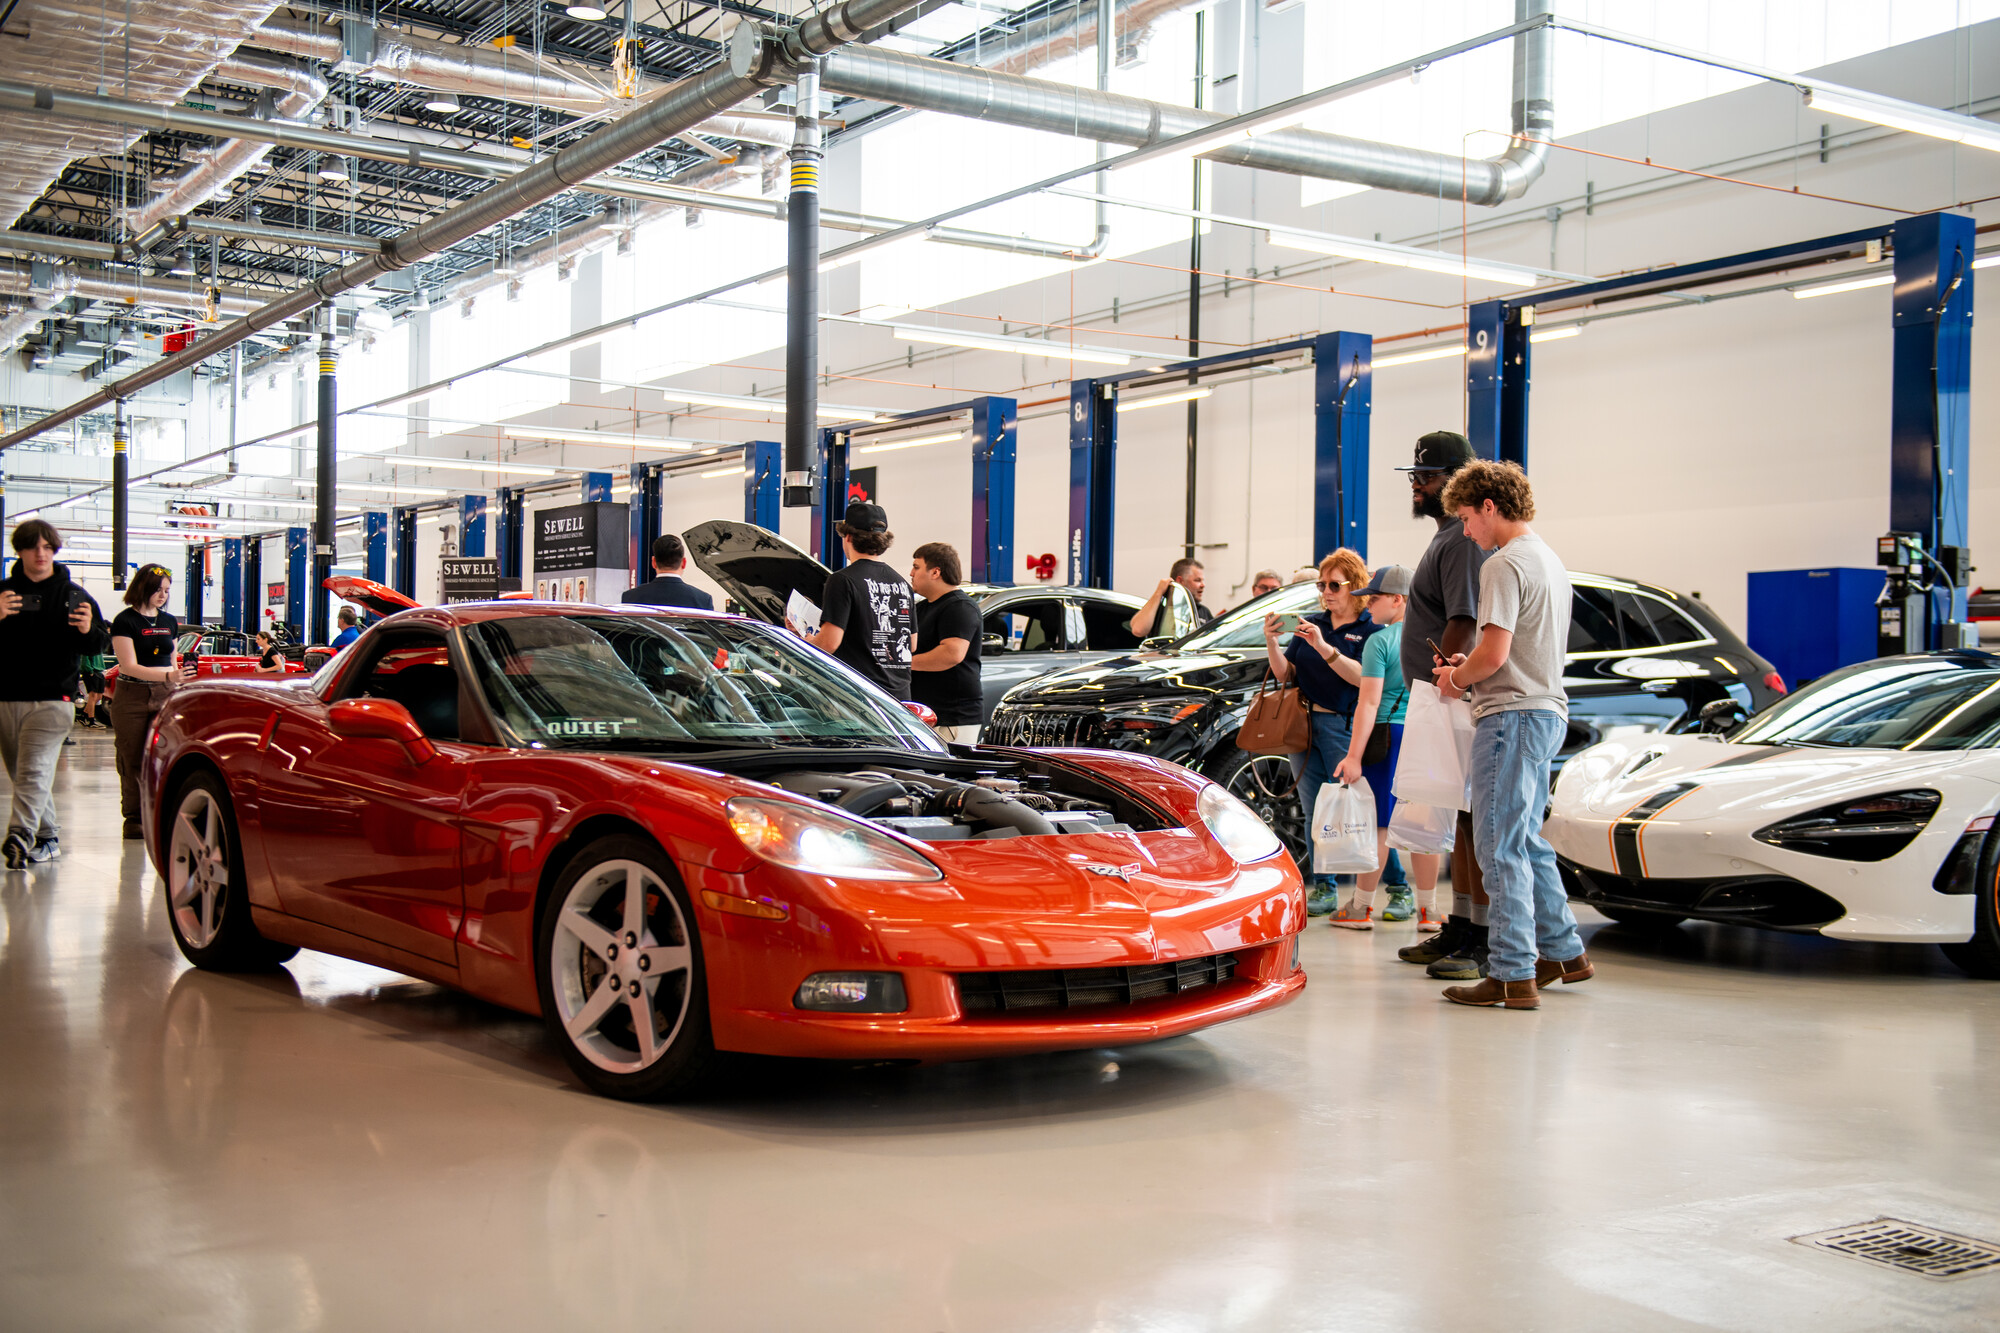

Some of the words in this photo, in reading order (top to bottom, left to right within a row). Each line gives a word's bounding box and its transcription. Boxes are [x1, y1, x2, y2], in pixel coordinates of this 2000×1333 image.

[1476, 329, 1488, 355] 9
[1074, 401, 1082, 422] 8
[544, 516, 585, 535] SEWELL
[1072, 528, 1081, 557] Lifts
[443, 563, 496, 576] SEWELL
[547, 721, 624, 735] QUIET
